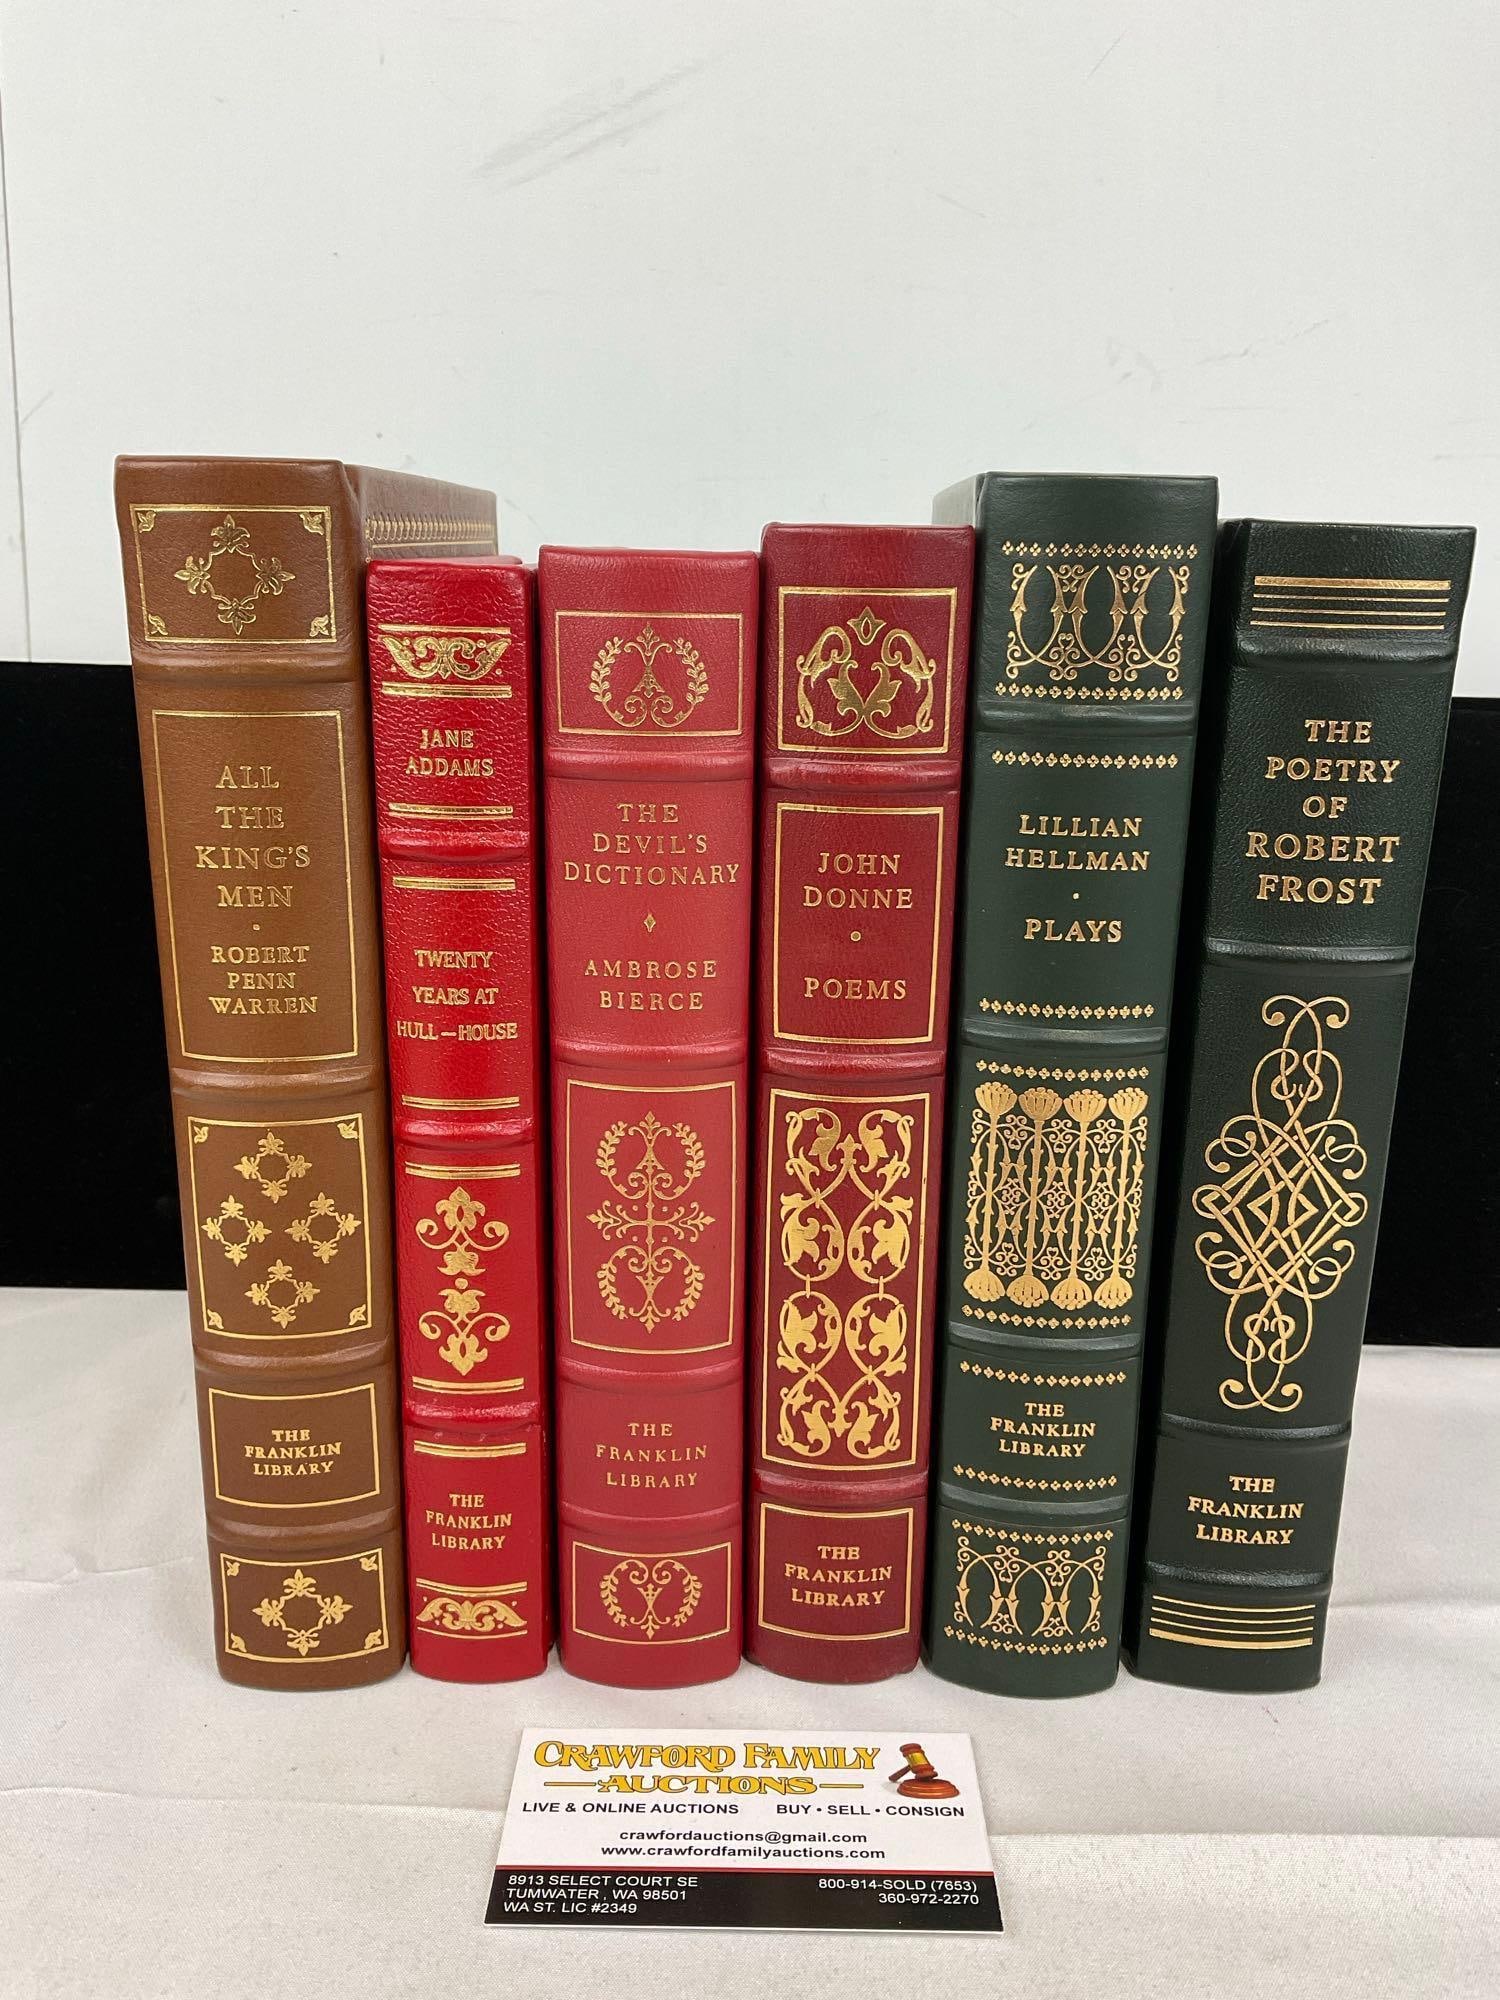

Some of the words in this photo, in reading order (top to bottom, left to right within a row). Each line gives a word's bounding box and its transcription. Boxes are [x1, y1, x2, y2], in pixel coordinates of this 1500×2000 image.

[419, 729, 475, 750] JANE
[1304, 719, 1373, 744] THE
[405, 757, 495, 777] ADDAMS
[1264, 756, 1401, 784] POETRY
[215, 765, 280, 790] ALL
[214, 805, 285, 829] THE
[616, 803, 679, 823] THE
[1302, 795, 1348, 820] OF
[1018, 814, 1143, 838] LILLIAN
[592, 832, 708, 854] DEVIL'S
[1245, 831, 1401, 863] ROBERT
[194, 844, 311, 869] KING'S
[817, 852, 902, 876] JOHN
[1004, 847, 1151, 872] HELLMAN
[563, 861, 740, 886] DICTIONARY
[217, 885, 294, 908] MEN
[802, 885, 913, 910] DONNE
[1256, 874, 1383, 904] FROST
[1024, 918, 1123, 943] PLAYS
[210, 945, 310, 964] ROBERT
[414, 950, 494, 969] TWENTY
[584, 960, 718, 979] AMBROSE
[227, 972, 296, 990] PENN
[803, 976, 907, 1001] POEMS
[208, 996, 318, 1015] WARREN
[411, 986, 471, 1006] YEARS
[473, 987, 499, 1006] AT
[599, 991, 704, 1011] BIERCE
[1024, 1402, 1065, 1419] THE
[271, 1429, 311, 1443] THE
[628, 1423, 674, 1438] THE
[989, 1417, 1097, 1438] FRANKLIN
[244, 1441, 343, 1459] FRANKLIN
[595, 1443, 709, 1465] FRANKLIN
[998, 1438, 1086, 1459] LIBRARY
[253, 1460, 335, 1476] LIBRARY
[606, 1471, 699, 1489] LIBRARY
[1228, 1474, 1275, 1494] THE
[448, 1493, 485, 1509] THE
[1187, 1496, 1303, 1520] FRANKLIN
[425, 1510, 513, 1530] FRANKLIN
[431, 1532, 506, 1551] LIBRARY
[1195, 1523, 1294, 1546] LIBRARY
[817, 1545, 861, 1561] THE
[784, 1563, 893, 1584] FRANKLIN
[790, 1587, 886, 1608] LIBRARY
[597, 1775, 818, 1796] AUCTIONS
[522, 1802, 561, 1813] LIVE
[565, 1802, 577, 1813] &
[582, 1802, 646, 1813] ONLINE
[651, 1803, 740, 1814] AUCTIONS
[776, 1804, 812, 1815] BUY
[827, 1805, 871, 1815] SELL
[885, 1805, 965, 1817] CONSIGN
[619, 1830, 868, 1844] crawfordauctions@gmail.com
[600, 1845, 886, 1859] www.crawfordfamilyauctions.com
[508, 1875, 544, 1885] 8913
[548, 1875, 612, 1886] SELECT
[615, 1876, 673, 1887] COURT
[676, 1876, 699, 1887] SE
[818, 1878, 927, 1891] 800-914-SOLD
[930, 1879, 977, 1893] (7653)
[612, 1889, 639, 1900] WA
[642, 1890, 687, 1900] 98501
[878, 1893, 979, 1905] 360-972-2270
[503, 1902, 530, 1913] WA
[533, 1902, 556, 1913] ST.
[561, 1902, 587, 1913] LIC
[591, 1903, 638, 1913] #2349
